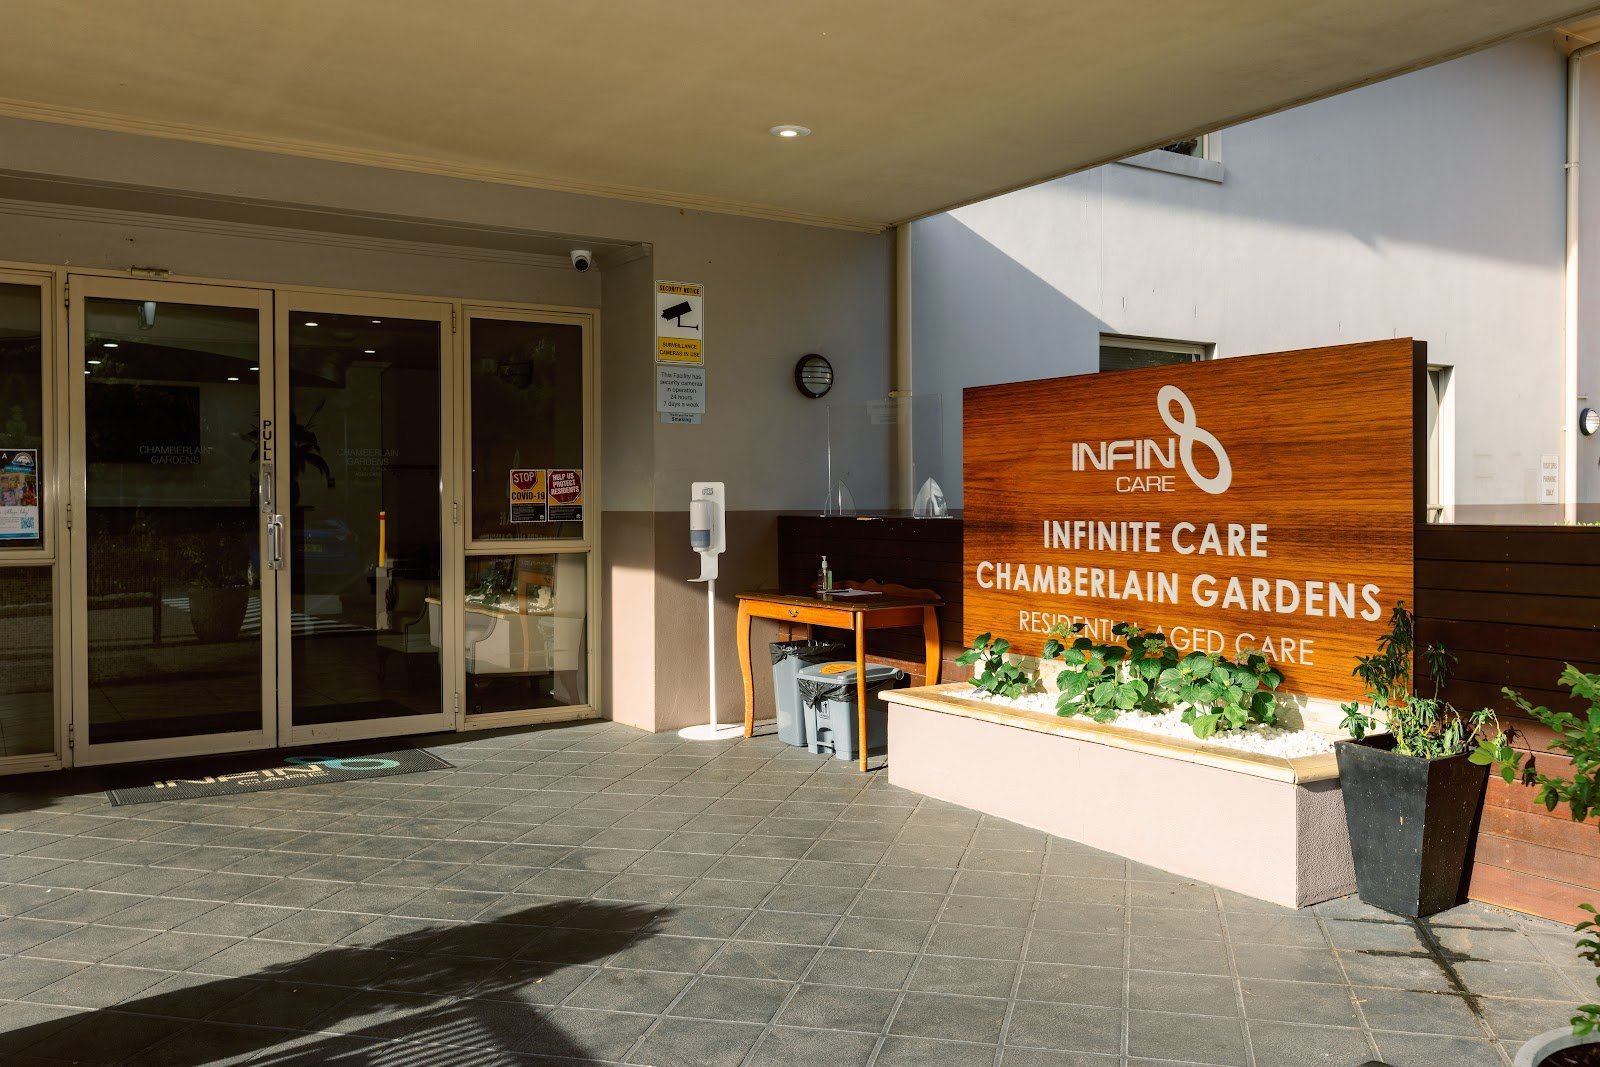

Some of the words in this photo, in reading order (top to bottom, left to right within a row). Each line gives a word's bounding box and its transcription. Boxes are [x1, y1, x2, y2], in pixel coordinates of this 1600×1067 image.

[659, 284, 682, 293] SECURITY
[683, 287, 700, 295] NOTICE
[662, 341, 697, 350] SURVEILLANCE
[262, 419, 272, 461] PULL
[139, 445, 211, 455] CHAMBERLAIN
[150, 455, 200, 465] GARDENS
[513, 472, 535, 483] STOP
[552, 473, 565, 481] HELP
[552, 479, 576, 488] PROTECT
[1116, 475, 1176, 493] CARE
[550, 486, 580, 495] RESIDENTS
[511, 491, 545, 501] COVID-19
[1043, 519, 1161, 553] INFINITE
[1171, 521, 1268, 558] CARE
[976, 560, 1179, 605] CHAMBERLAIN
[1191, 572, 1382, 623] GARDENS
[1019, 609, 1138, 643] RESIDENTI
[1235, 632, 1315, 666] CARE
